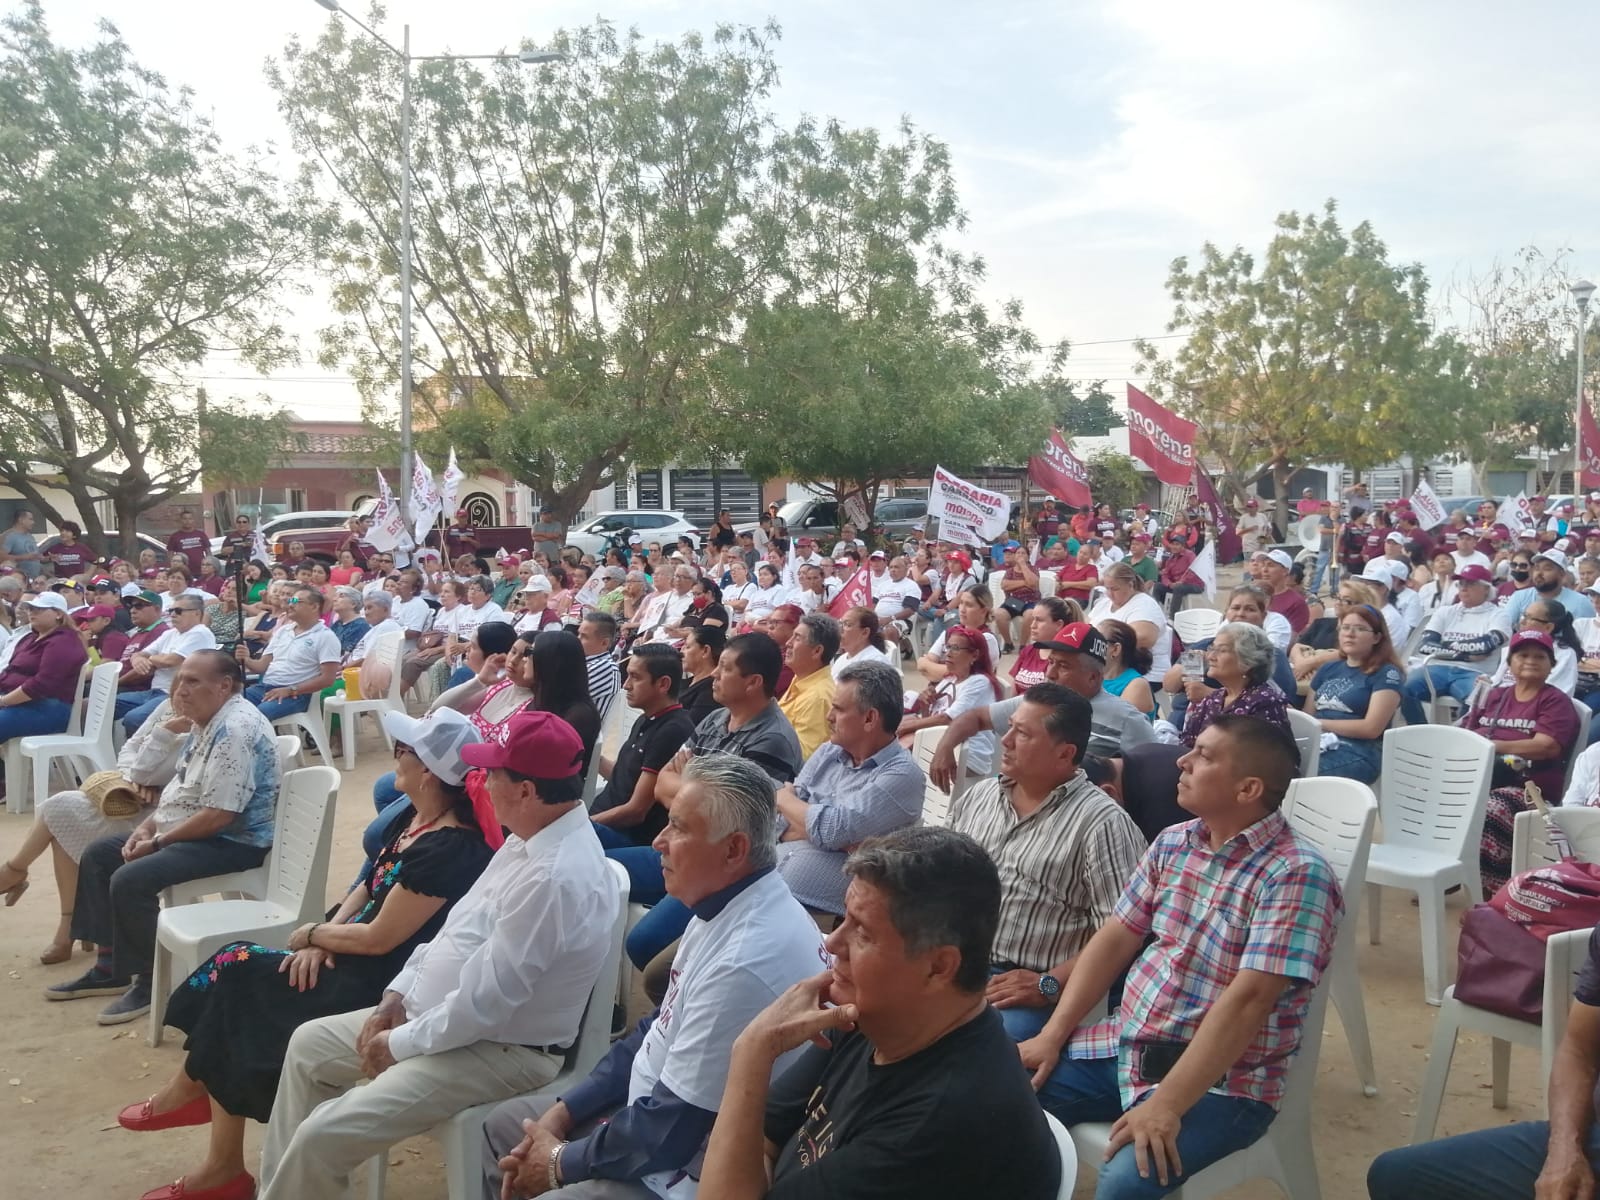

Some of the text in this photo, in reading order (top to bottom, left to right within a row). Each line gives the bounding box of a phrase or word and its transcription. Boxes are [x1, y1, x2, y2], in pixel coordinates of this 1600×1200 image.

[1128, 408, 1192, 458] morena
[1043, 439, 1088, 480] orena
[1449, 641, 1486, 653] AKRON
